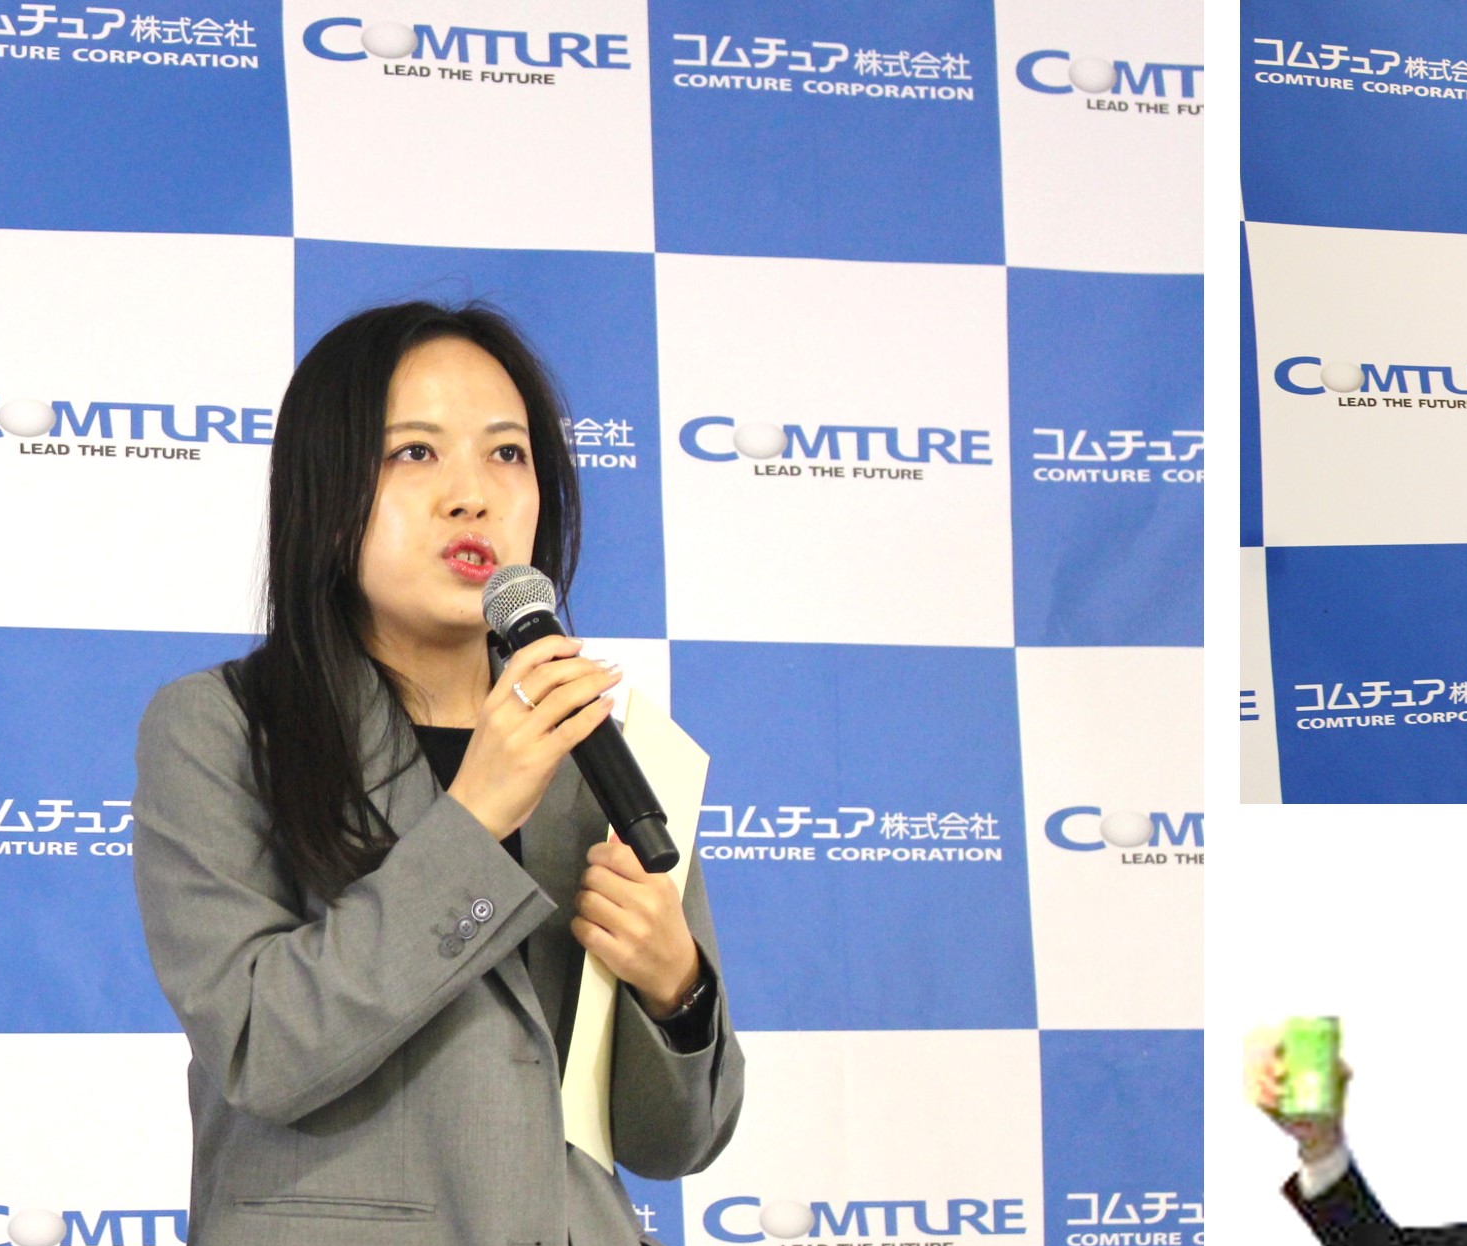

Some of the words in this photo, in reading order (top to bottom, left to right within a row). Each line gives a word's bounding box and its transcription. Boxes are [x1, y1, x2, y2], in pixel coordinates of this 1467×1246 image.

[73, 48, 258, 68] CORPORATION
[673, 33, 972, 80] コムチュア株式会社
[384, 64, 430, 77] LEAD
[438, 68, 472, 80] THE
[481, 72, 554, 84] FUTURE
[1255, 72, 1353, 90] COMTURE
[674, 74, 792, 91] COMTURE
[803, 80, 973, 100] CORPORATION
[1087, 99, 1128, 111] LEAD
[1136, 103, 1168, 114] THE
[1339, 398, 1376, 406] LEAD
[1383, 398, 1412, 407] THE
[20, 443, 69, 455] LEAD
[78, 445, 116, 456] THE
[126, 447, 200, 460] FUTURE
[755, 465, 801, 476] LEAD
[809, 466, 844, 477] THE
[853, 468, 922, 480] FUTURE
[1034, 468, 1150, 482] COMTURE
[1297, 715, 1395, 729] COMTURE
[700, 846, 815, 860] COMTURE
[827, 848, 1002, 861] CORPORATION
[1122, 854, 1167, 864] LEAD
[1067, 1233, 1181, 1246] COMTURE
